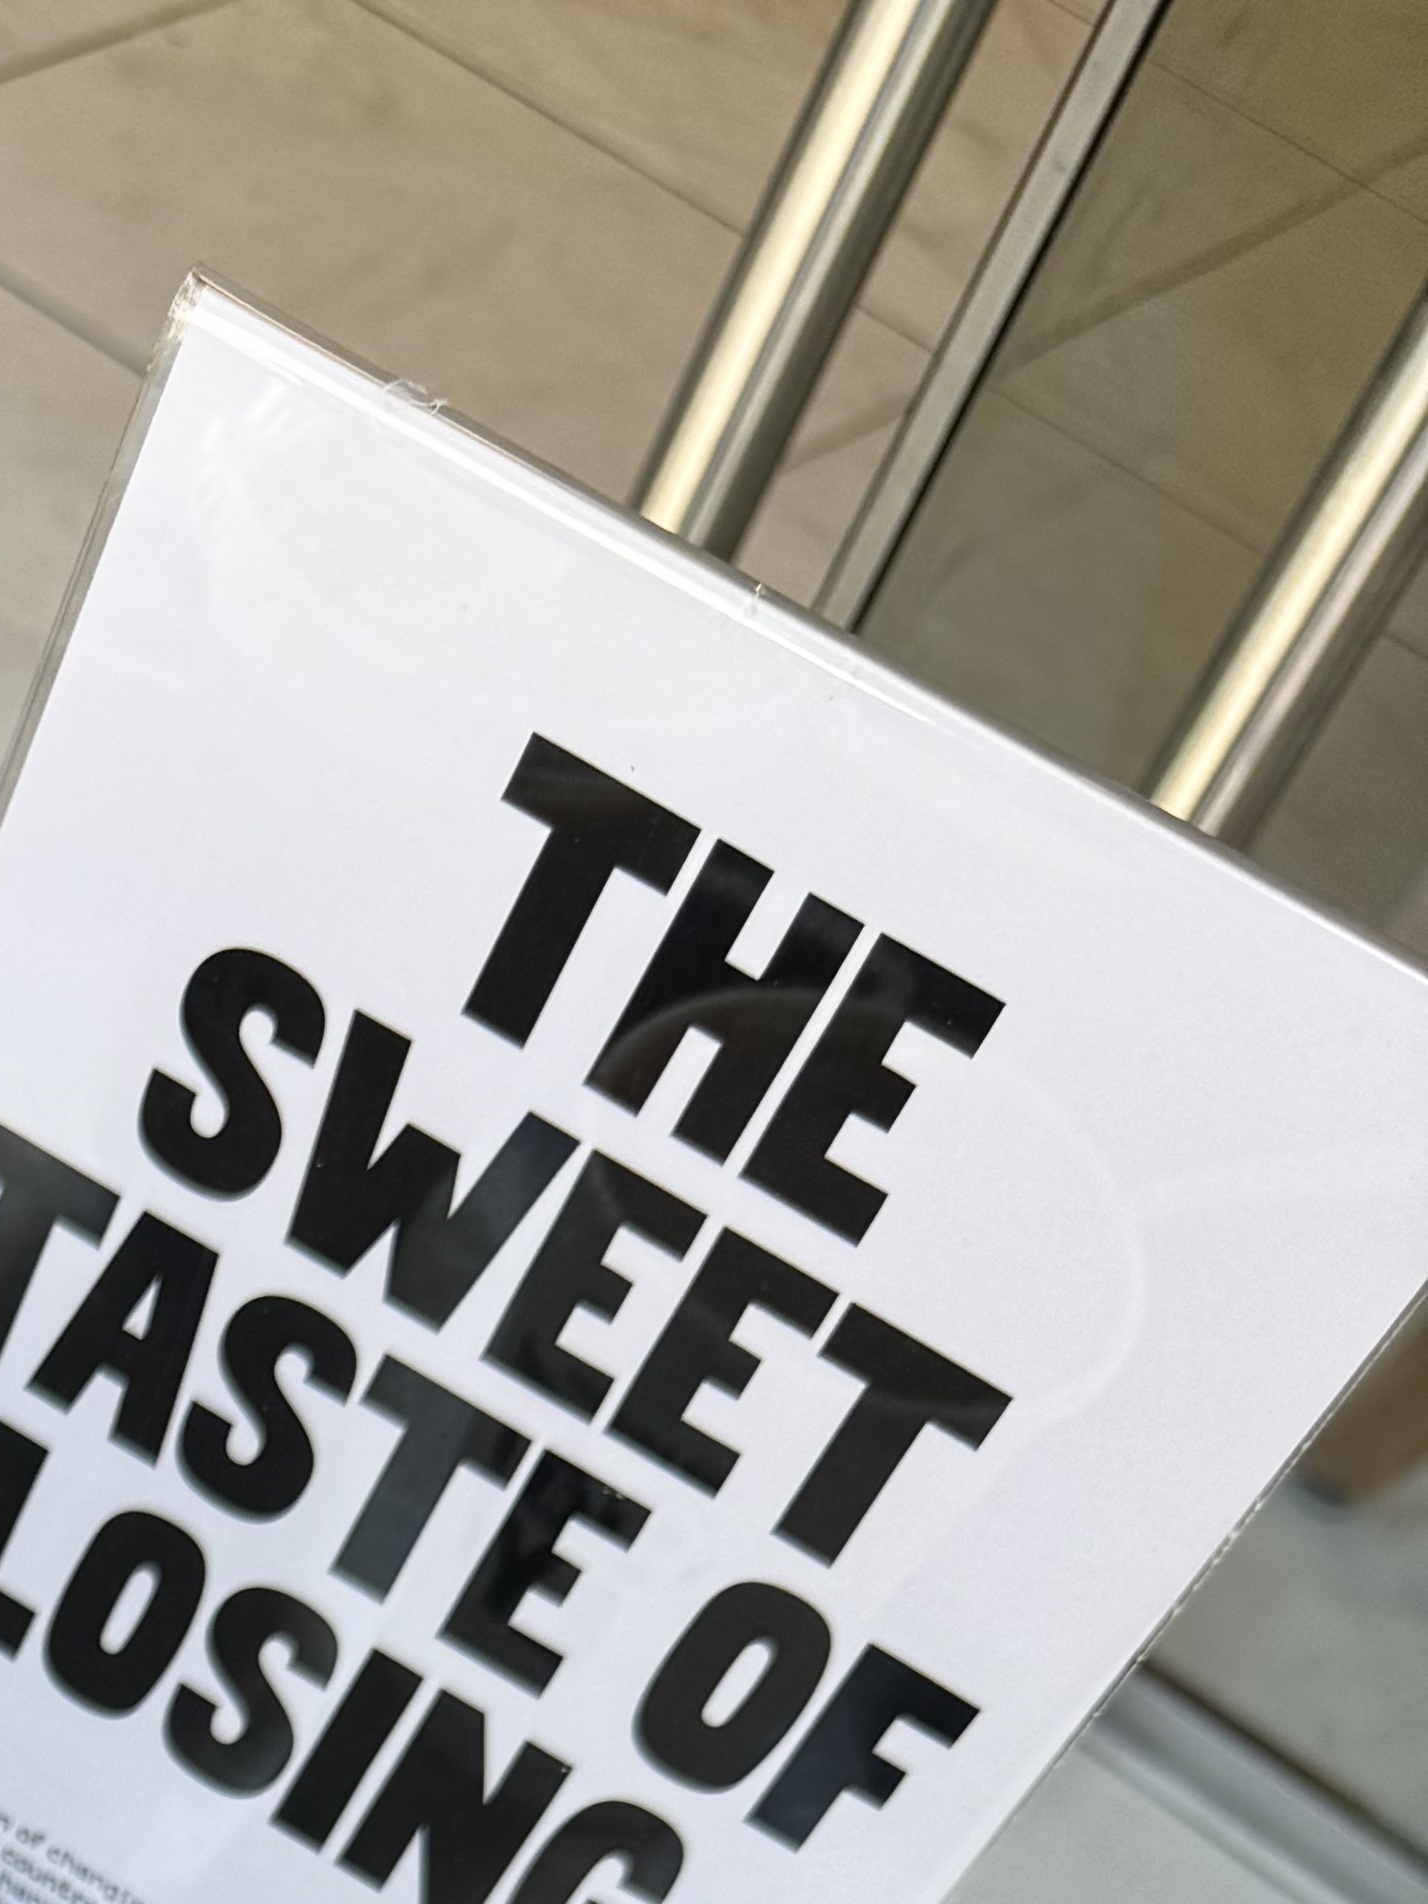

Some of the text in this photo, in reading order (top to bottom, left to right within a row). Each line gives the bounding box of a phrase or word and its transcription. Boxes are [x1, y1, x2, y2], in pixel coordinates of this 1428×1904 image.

[461, 731, 1006, 1247] THE
[138, 947, 1013, 1566] SWEET
[632, 1582, 980, 1852] OF
